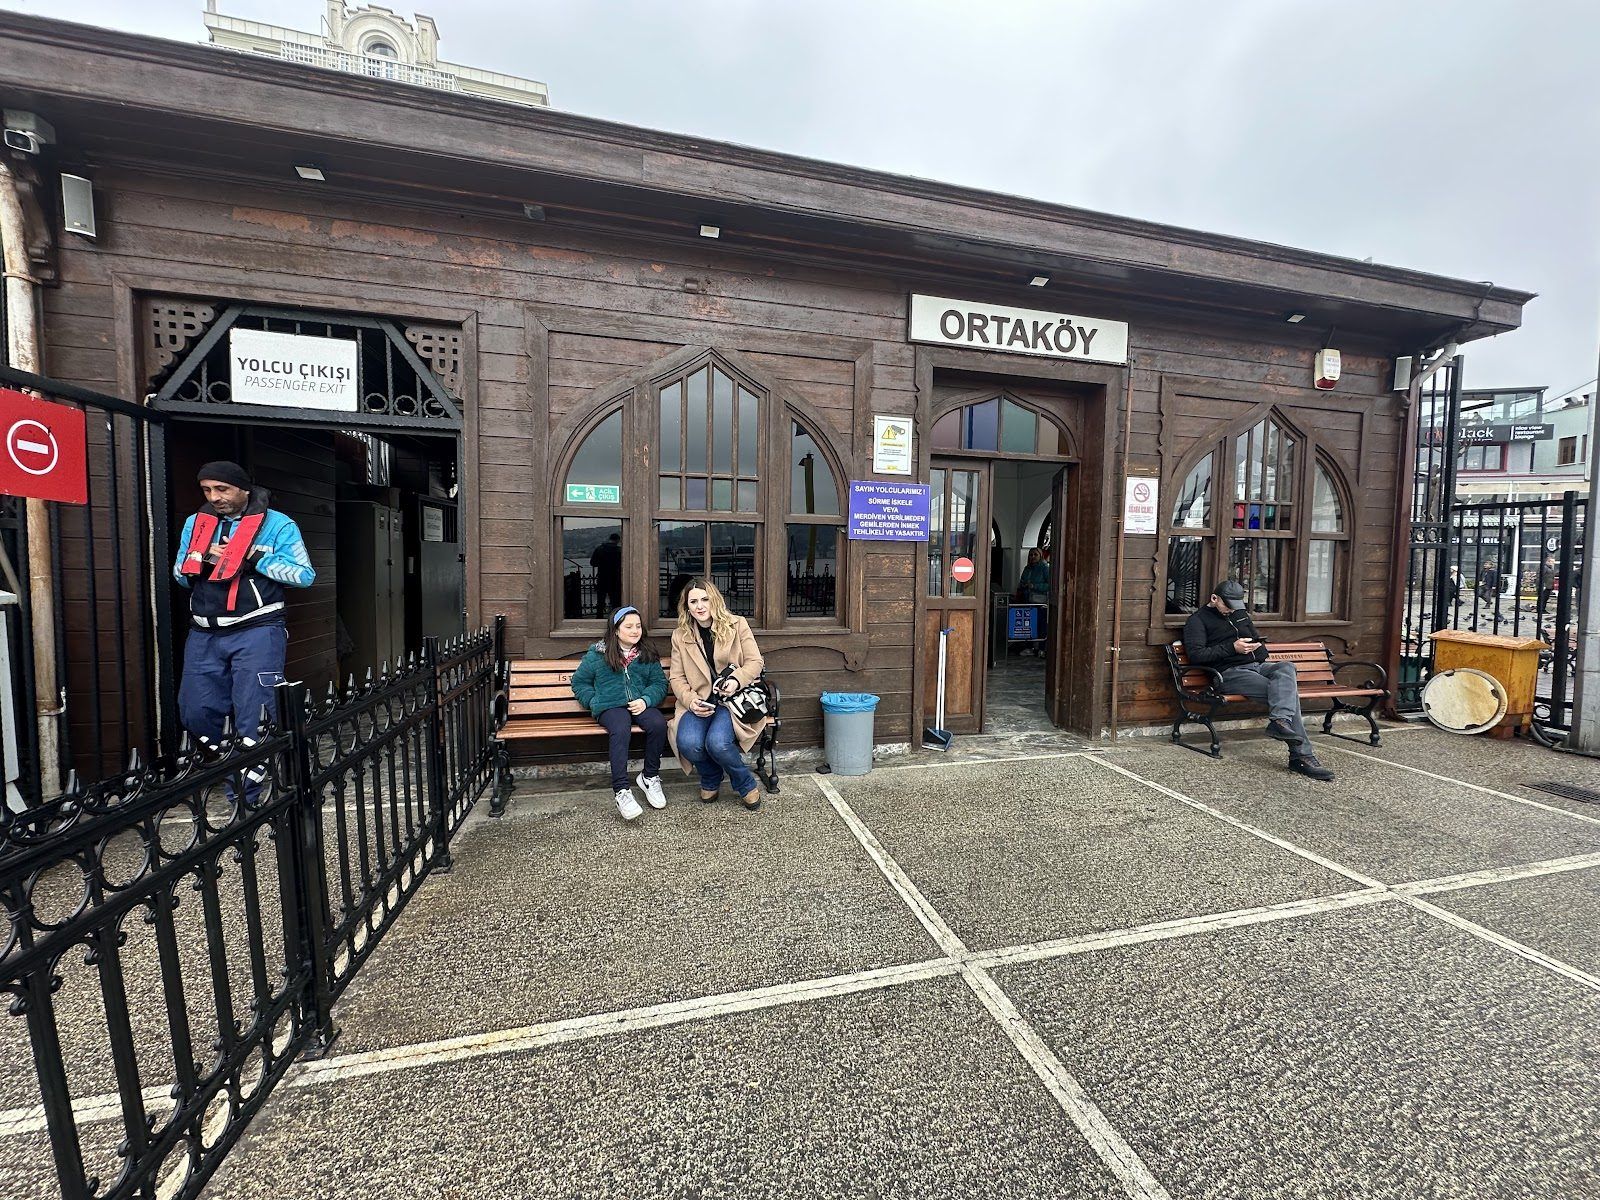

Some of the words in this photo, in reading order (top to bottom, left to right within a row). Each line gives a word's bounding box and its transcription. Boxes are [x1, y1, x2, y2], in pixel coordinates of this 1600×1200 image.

[940, 309, 1098, 355] ORTAKÖY
[237, 357, 293, 375] YOLCU
[300, 363, 350, 382] ÇIKIŞI
[244, 376, 316, 392] PASSENGER
[319, 383, 346, 394] EXIT
[1458, 427, 1494, 438] lack
[854, 485, 875, 493] SAYIN
[875, 486, 922, 495] YOLCULARIMIZ
[868, 497, 891, 505] SÜRME
[891, 498, 913, 506] İSKELE
[887, 513, 926, 522] VERİLMEDEN
[859, 520, 900, 528] GEMİLERDEN
[900, 521, 920, 529] İNMEK
[853, 528, 885, 536] TEHLİKELİ
